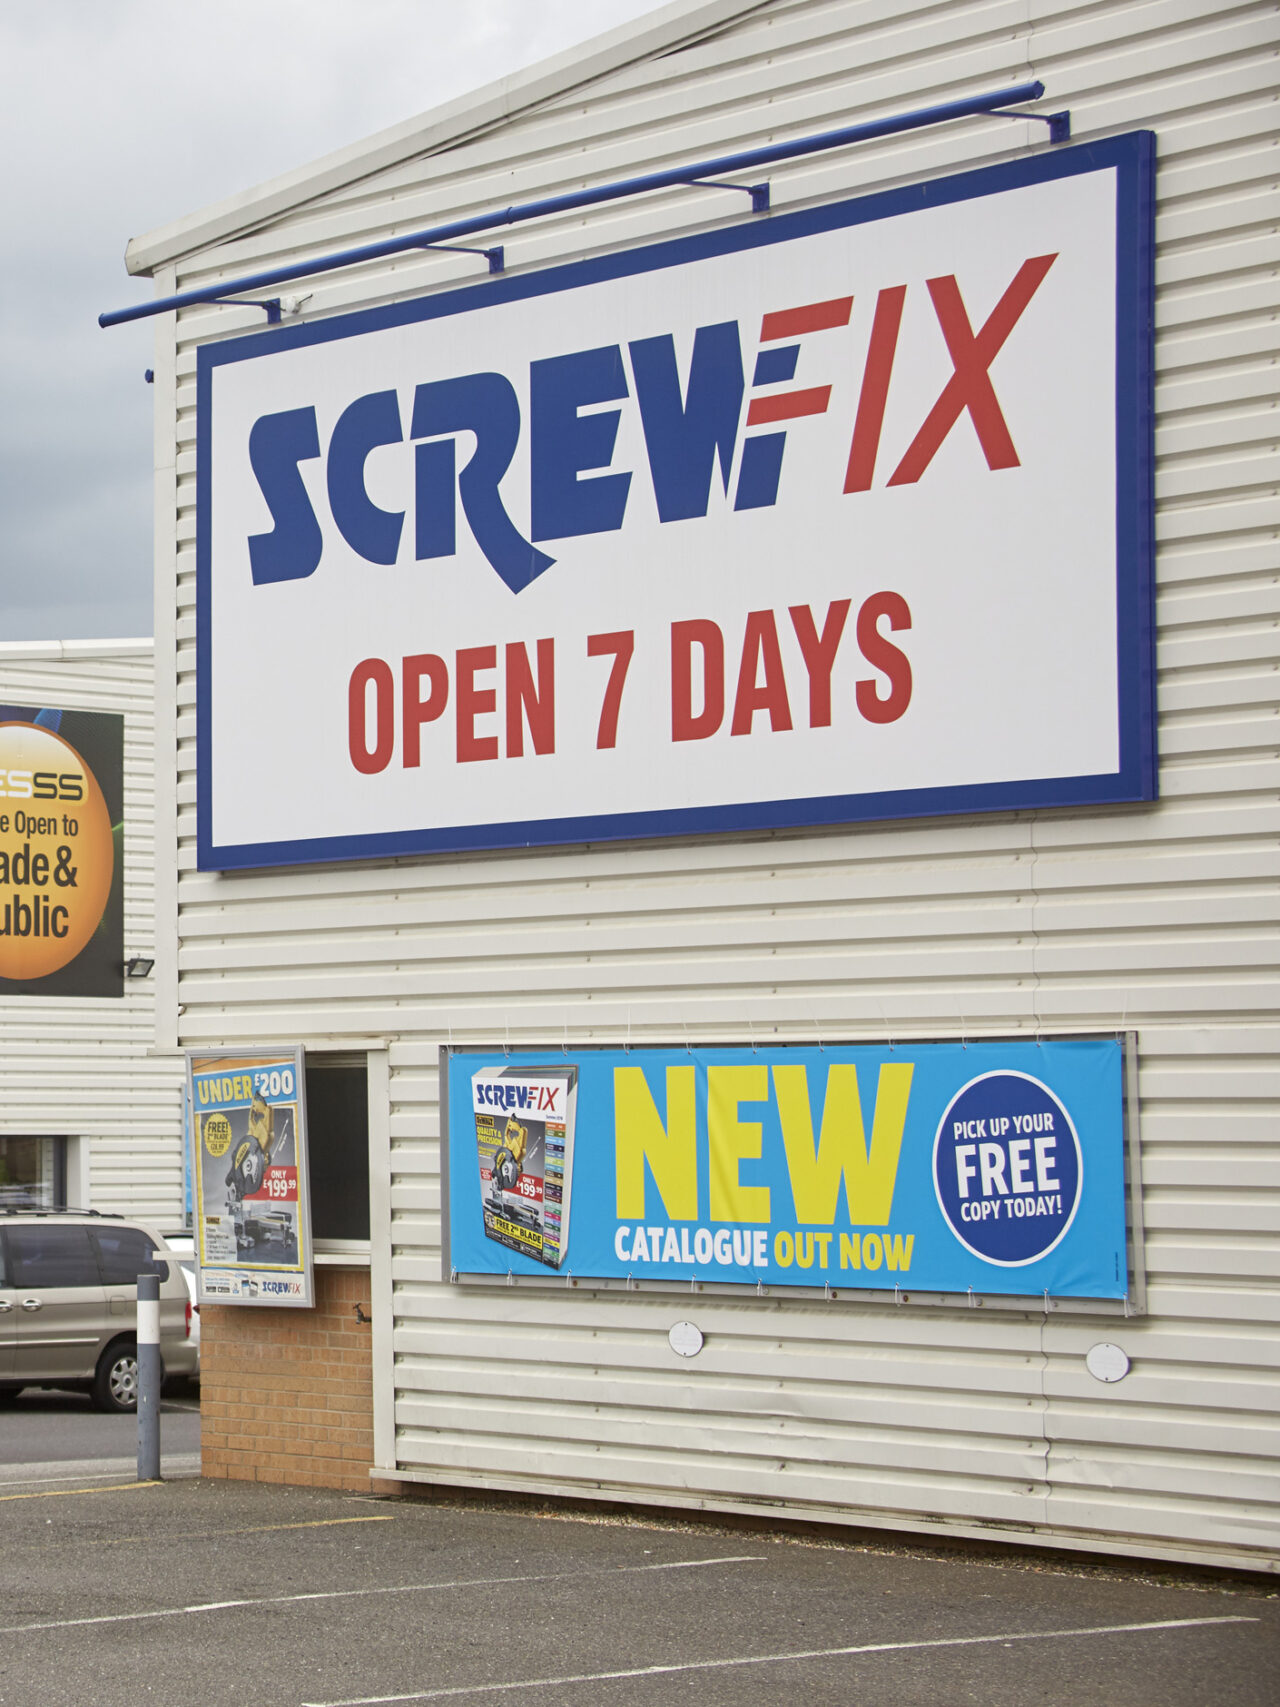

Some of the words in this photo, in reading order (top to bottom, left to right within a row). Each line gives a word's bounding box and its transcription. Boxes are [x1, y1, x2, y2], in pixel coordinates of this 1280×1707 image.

[247, 252, 1060, 595] SCREWFIX
[348, 636, 556, 776] OPEN
[587, 629, 635, 750] 7
[670, 590, 914, 743] DAYS
[14, 810, 57, 839] Open
[62, 814, 79, 837] to
[53, 845, 78, 888] &
[197, 1075, 254, 1105] UNDER
[254, 1070, 294, 1097] £200
[476, 1084, 560, 1111] SCREWFIX
[207, 1121, 229, 1133] FREE!
[953, 1119, 988, 1140] PICK
[989, 1116, 1011, 1138] UP
[1012, 1112, 1054, 1135] YOUR
[613, 1062, 916, 1226] NEW
[270, 1170, 287, 1179] ONLY
[523, 1176, 535, 1185] ONLY
[954, 1136, 1062, 1199] FREE
[960, 1199, 1002, 1223] COPY
[1003, 1194, 1063, 1219] TODAY!
[496, 1218, 510, 1232] FREE
[520, 1228, 542, 1244] BLADE
[614, 1227, 769, 1268] CATALOGUE
[773, 1232, 833, 1269] OUT
[839, 1233, 916, 1271] NOW
[262, 1281, 301, 1295] SCREWFIX
